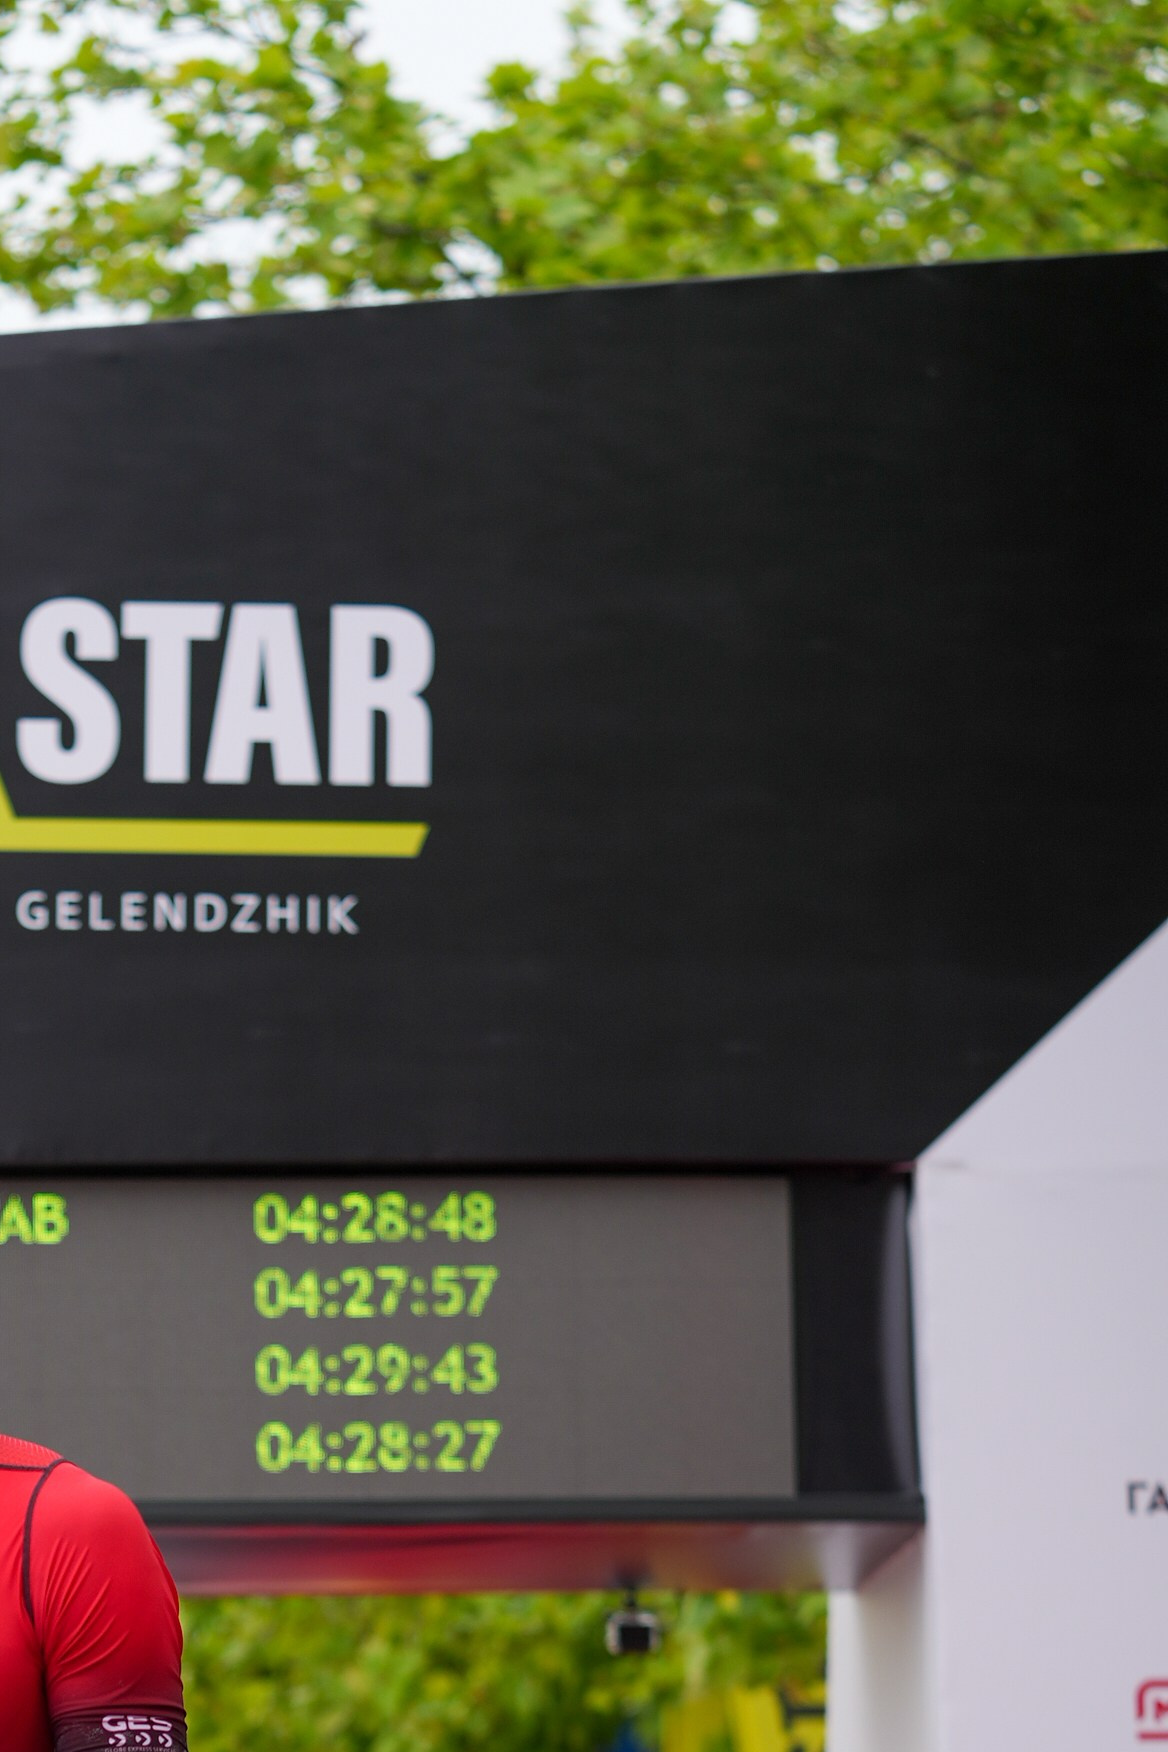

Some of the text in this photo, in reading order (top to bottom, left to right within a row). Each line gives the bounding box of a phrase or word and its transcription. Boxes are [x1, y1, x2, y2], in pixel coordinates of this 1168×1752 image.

[16, 597, 434, 787] STAR
[15, 890, 360, 935] GELENDZHIK
[253, 1192, 496, 1244] 04:28:48
[253, 1265, 498, 1319] 04:27:57
[254, 1342, 499, 1397] 04:29:43
[255, 1420, 500, 1473] 04:28:27
[102, 1715, 172, 1732] GES
